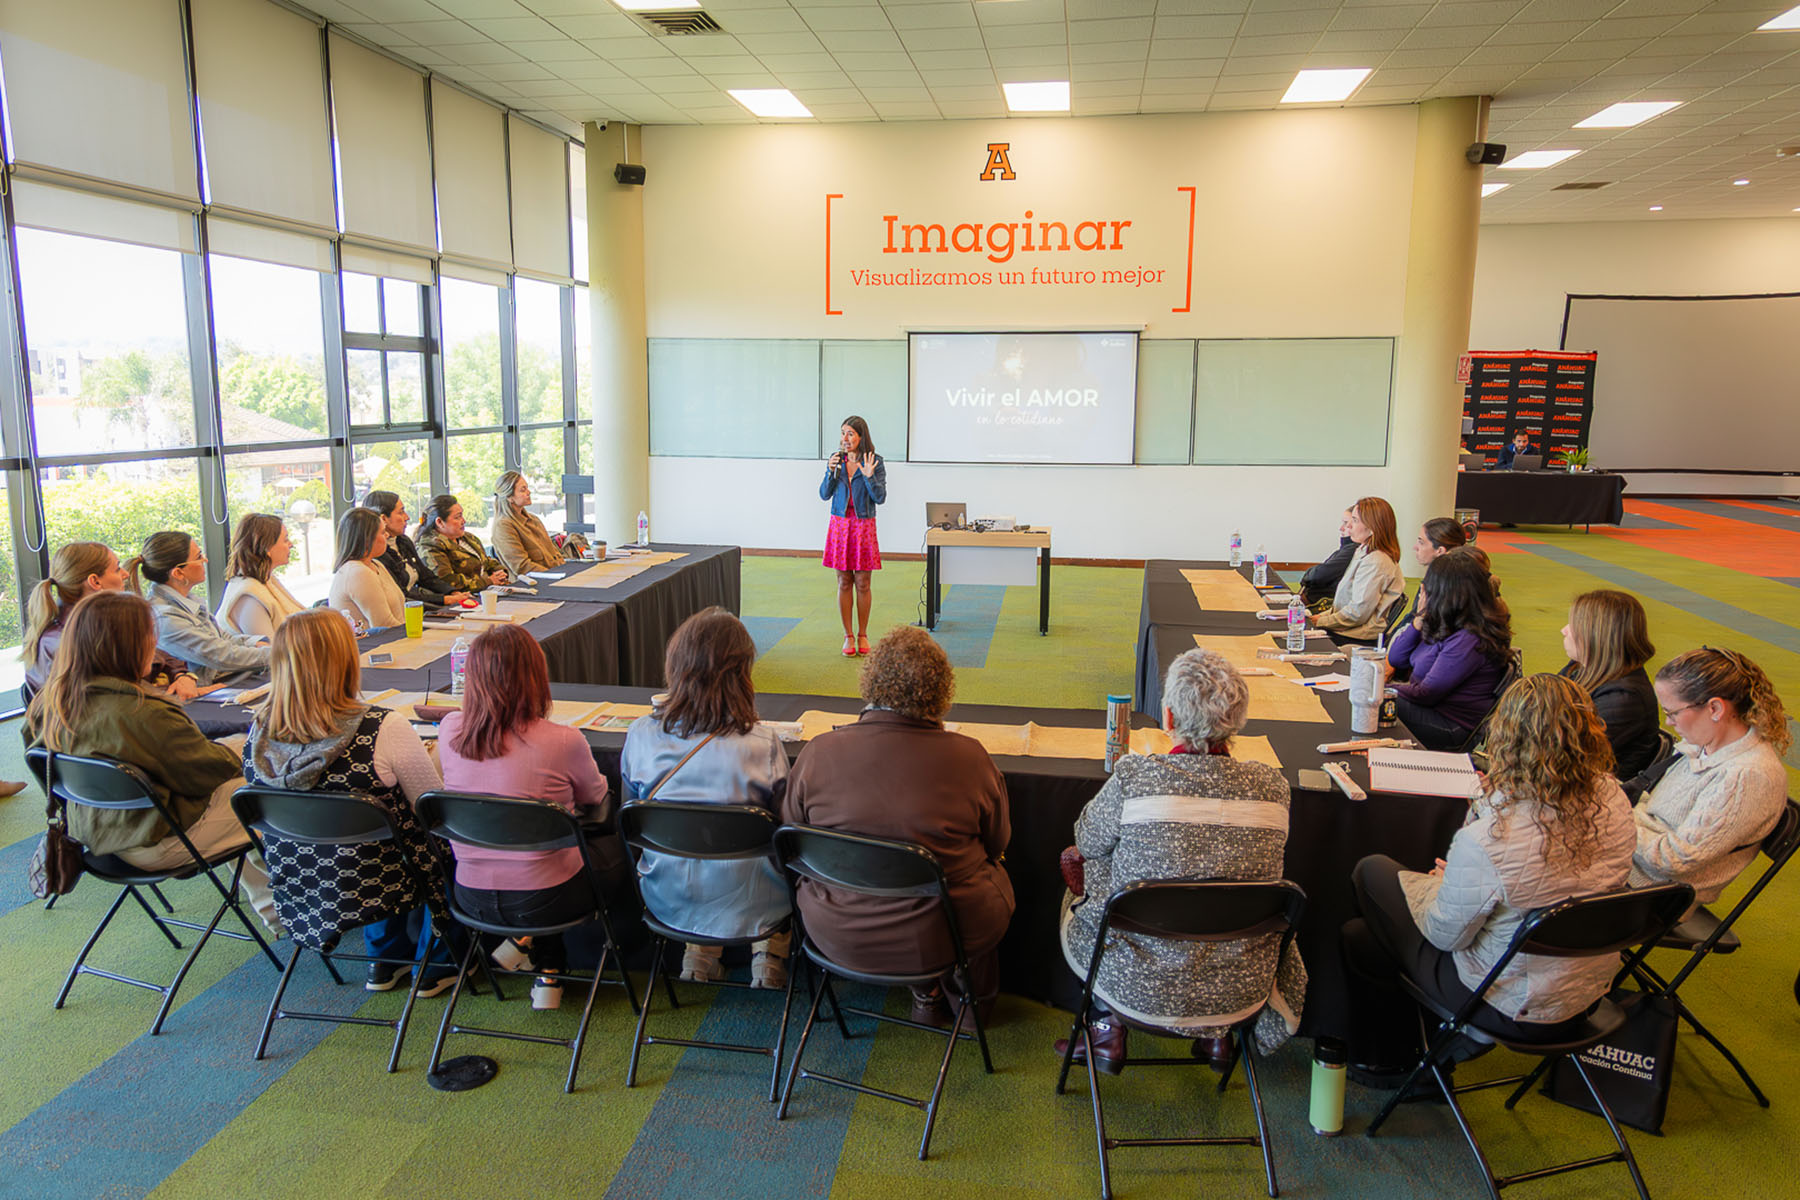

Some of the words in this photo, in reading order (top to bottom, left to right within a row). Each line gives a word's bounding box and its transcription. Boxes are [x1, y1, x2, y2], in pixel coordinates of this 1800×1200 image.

[980, 143, 1016, 181] A
[883, 210, 1132, 263] Imaginar
[850, 268, 992, 287] Visualizamos
[999, 271, 1025, 286] un
[1031, 266, 1096, 285] futuro
[1101, 266, 1166, 287] mejor
[946, 388, 996, 407] Vivir
[1001, 388, 1021, 407] el
[1027, 389, 1099, 407] AMOR
[1580, 1055, 1611, 1069] cación
[1612, 1063, 1653, 1081] Continua
[1587, 1044, 1655, 1070] AHUAC
